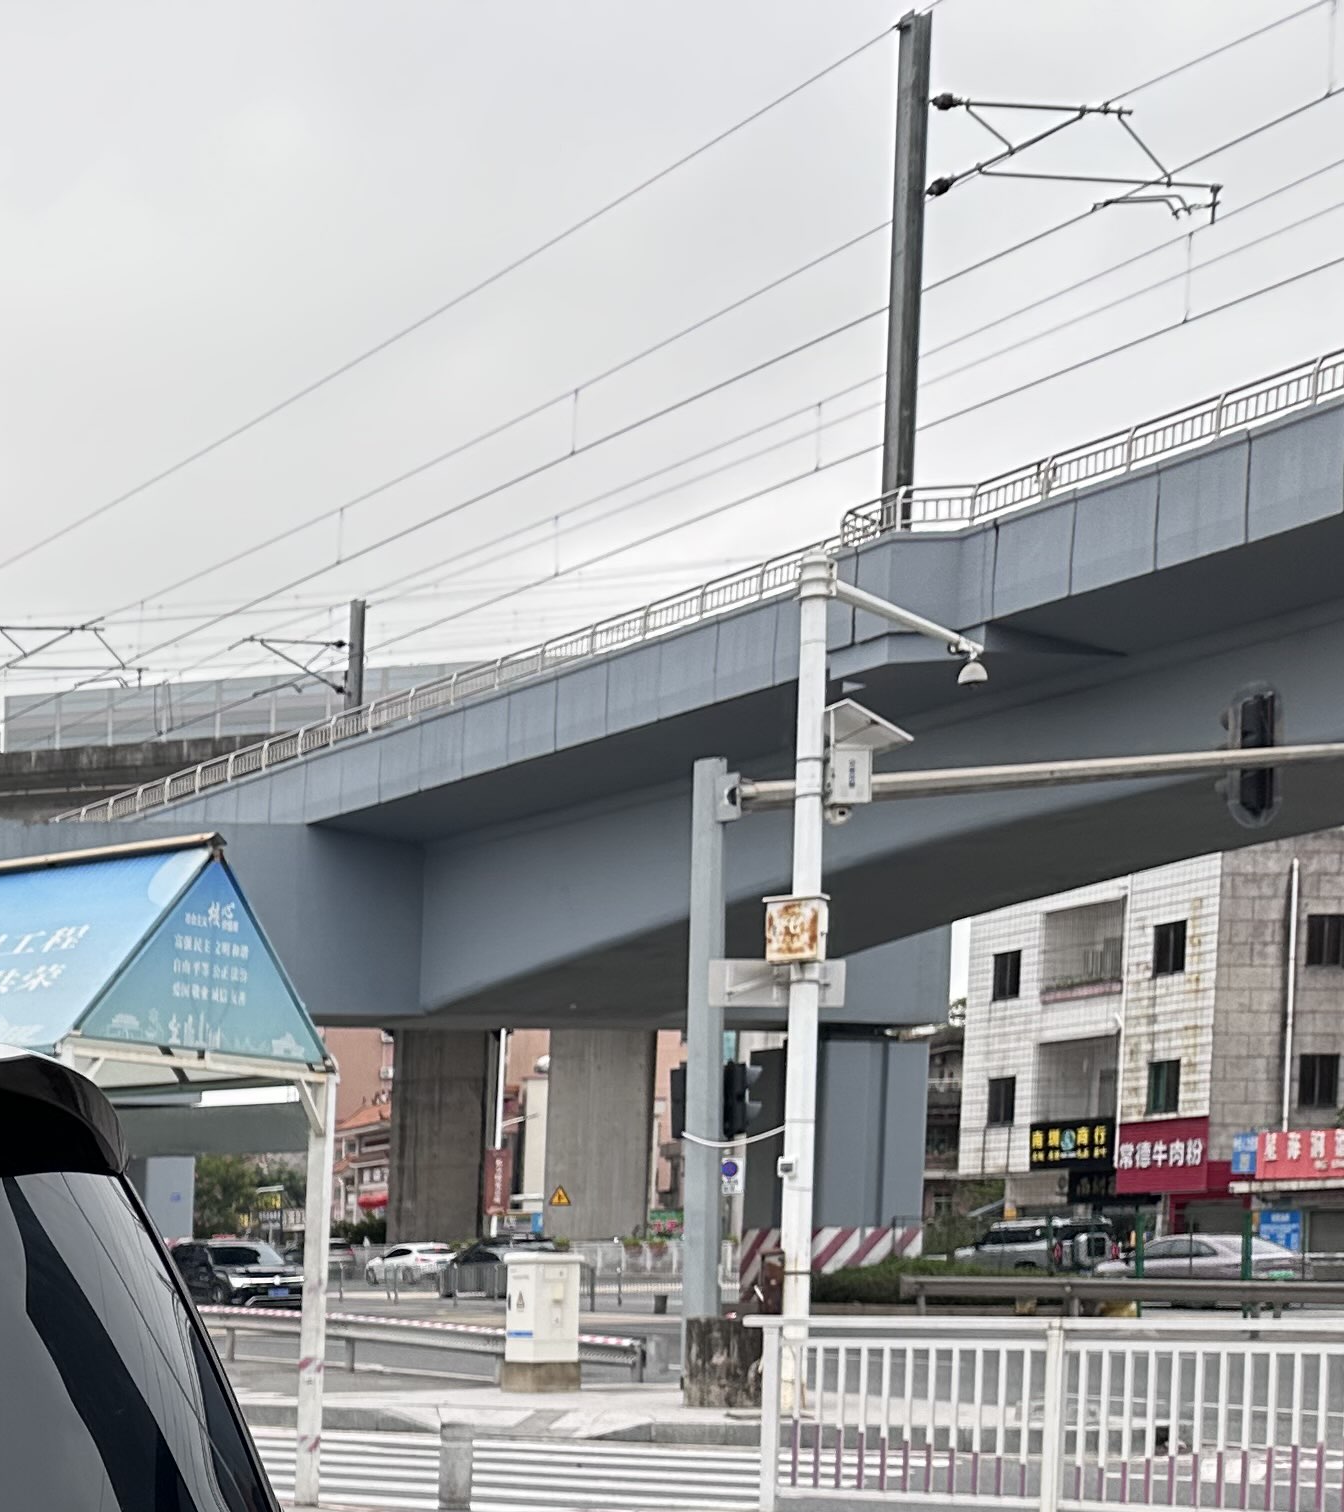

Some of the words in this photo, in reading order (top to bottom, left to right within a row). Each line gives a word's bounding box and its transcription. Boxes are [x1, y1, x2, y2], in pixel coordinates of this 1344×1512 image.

[1119, 1138, 1203, 1170] 常德牛肉粉
